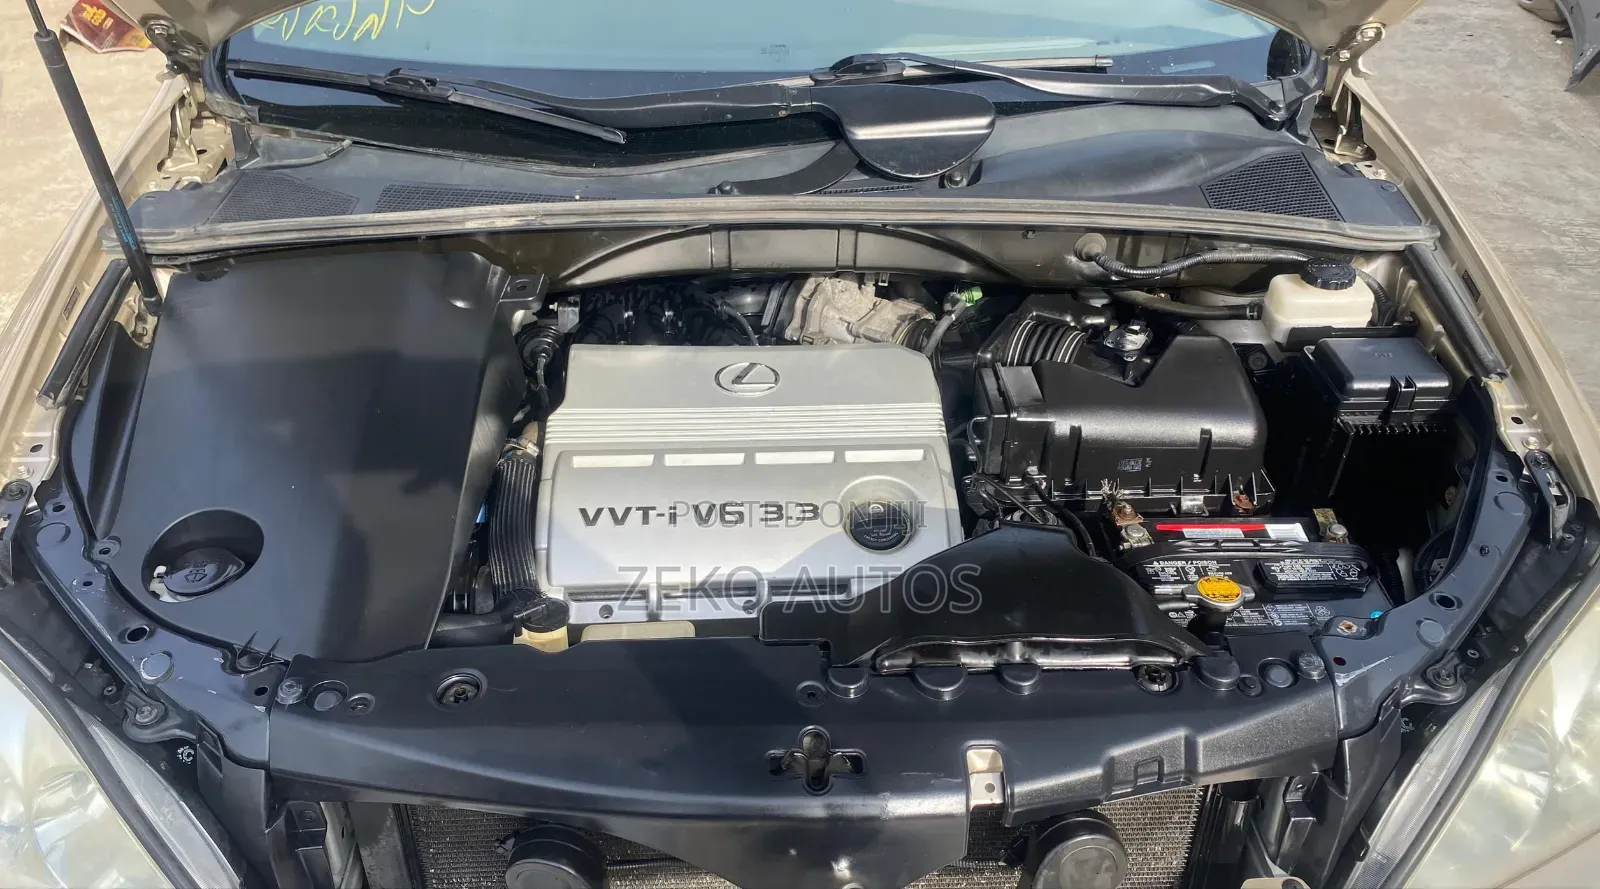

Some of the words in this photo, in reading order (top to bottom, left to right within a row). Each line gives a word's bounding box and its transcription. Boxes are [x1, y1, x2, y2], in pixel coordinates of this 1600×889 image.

[579, 506, 677, 526] VVT-i
[692, 502, 745, 525] V6
[759, 502, 820, 522] 3.3
